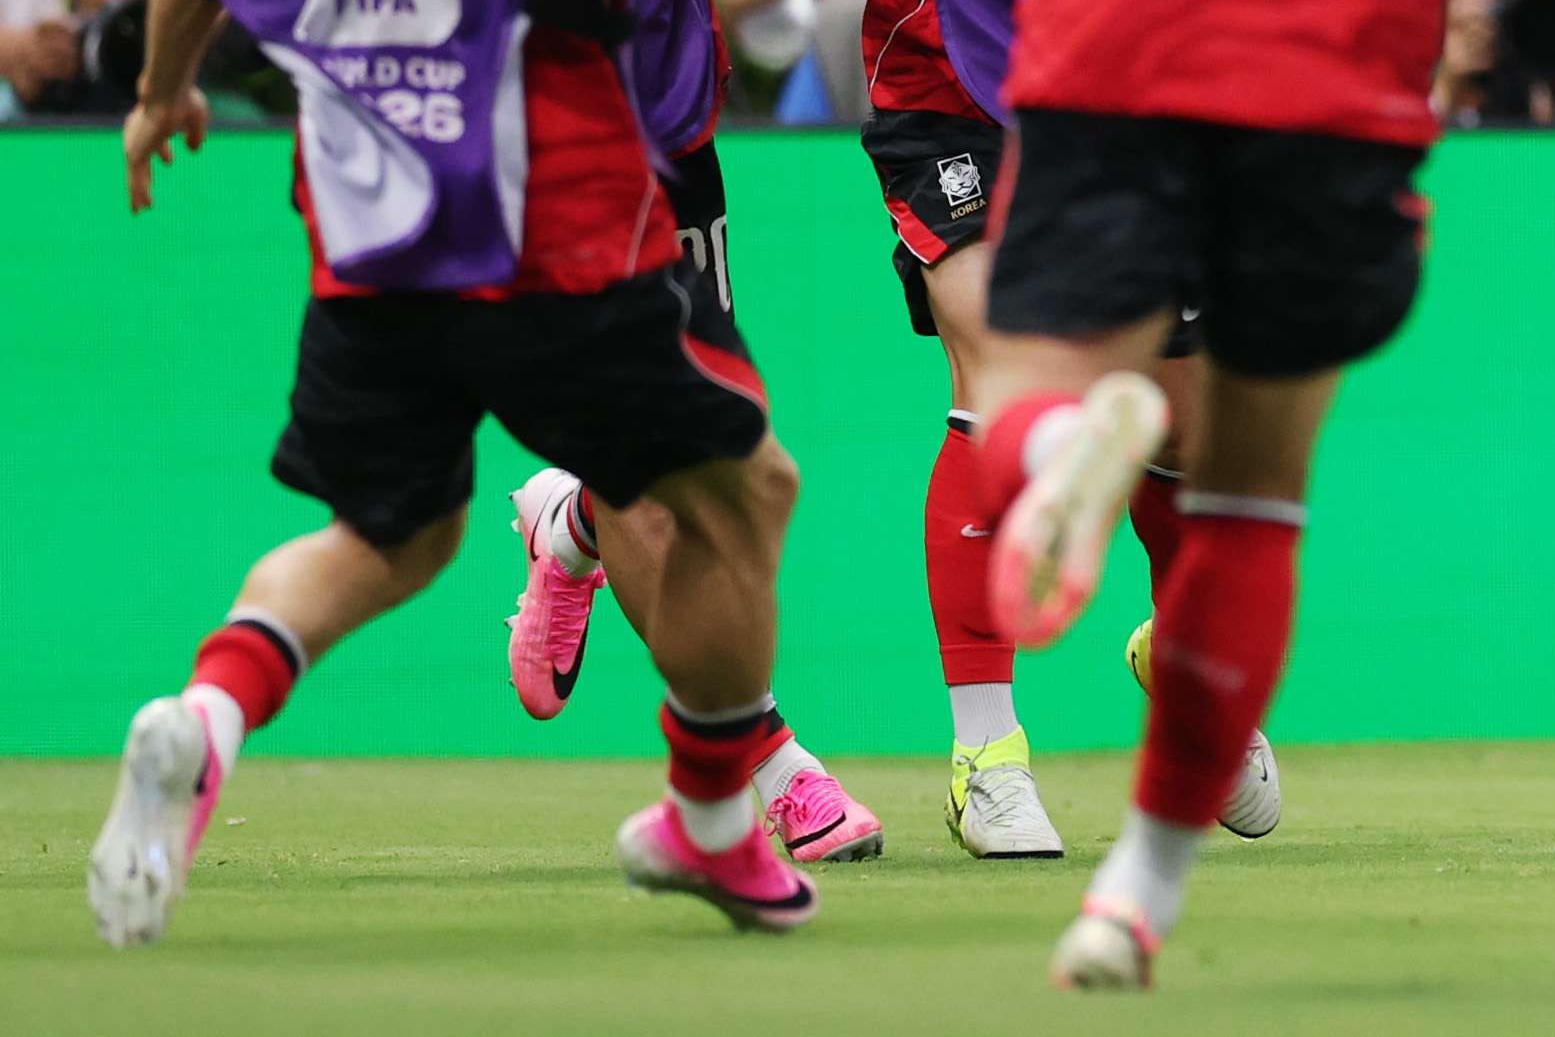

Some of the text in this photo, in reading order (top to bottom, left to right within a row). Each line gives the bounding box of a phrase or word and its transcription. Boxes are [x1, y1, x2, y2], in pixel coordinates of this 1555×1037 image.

[404, 56, 467, 91] CUP
[366, 88, 466, 143] 26
[950, 198, 987, 220] KOREA
